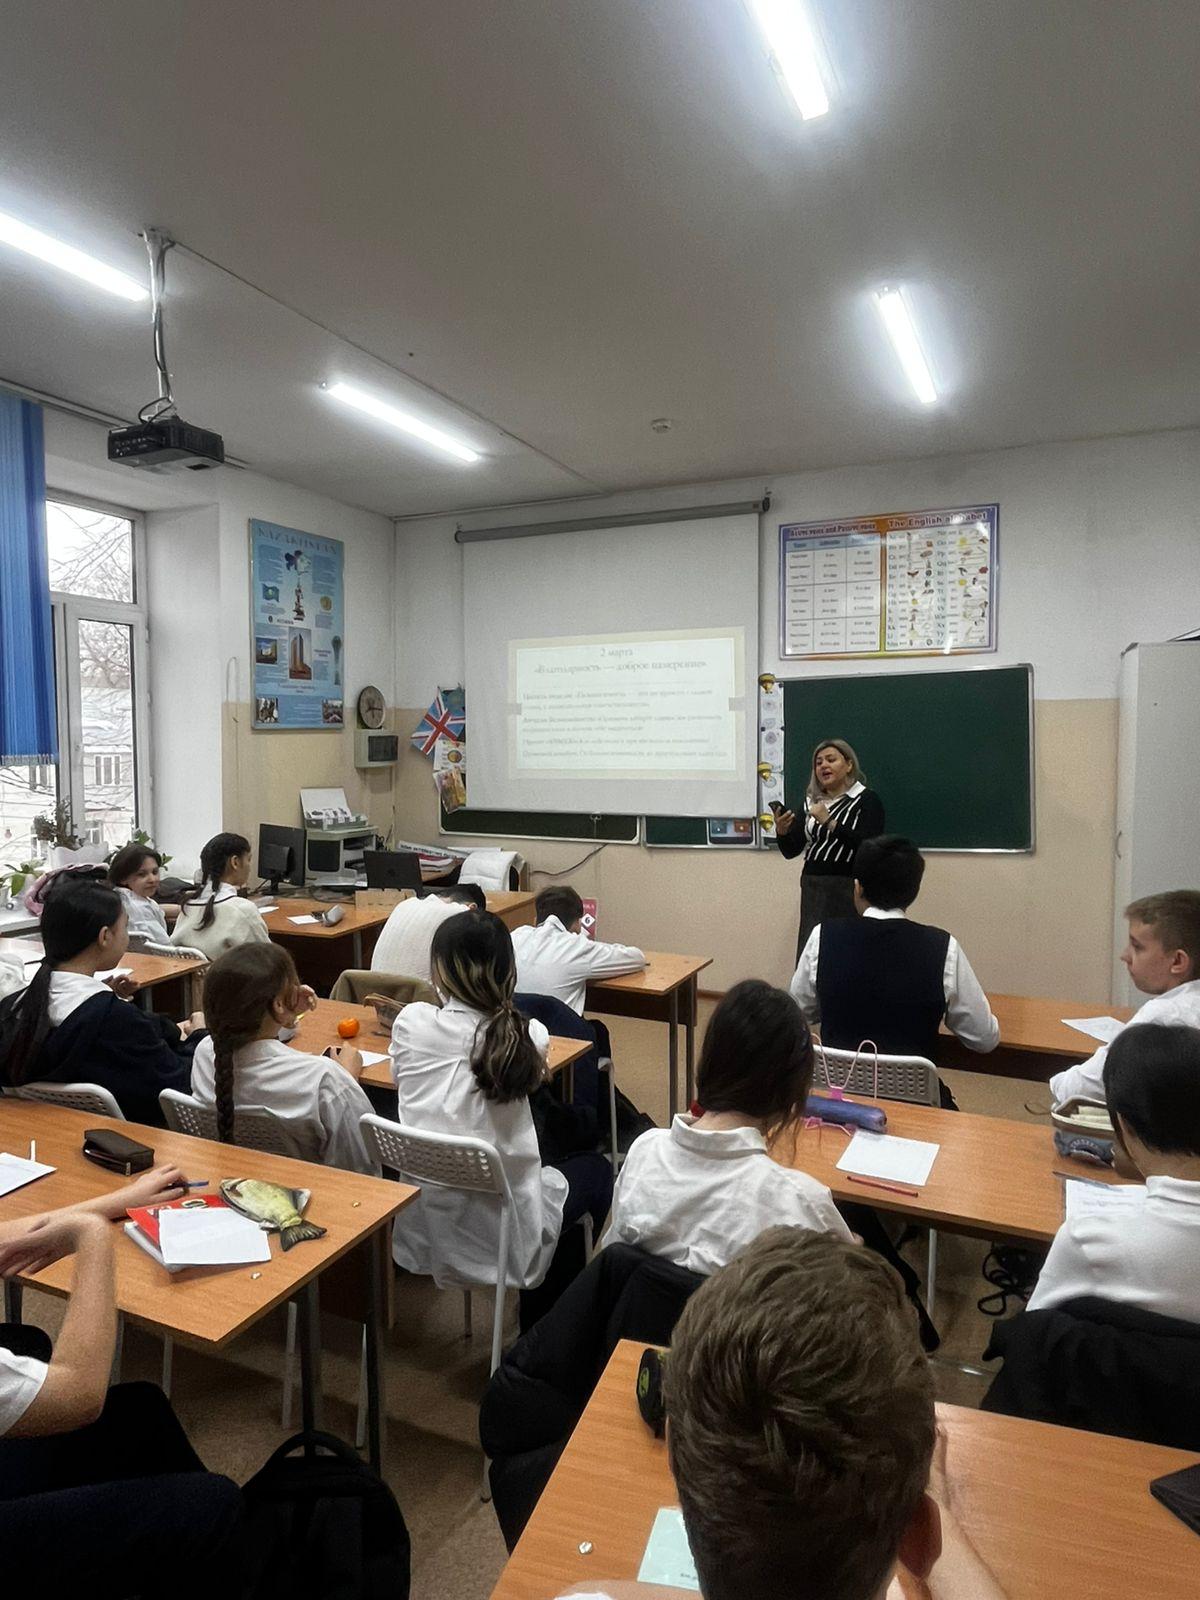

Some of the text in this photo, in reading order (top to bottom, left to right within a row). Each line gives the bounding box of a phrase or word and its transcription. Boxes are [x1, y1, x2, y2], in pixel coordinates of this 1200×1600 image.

[889, 518, 906, 529] The
[909, 515, 942, 528] English
[826, 525, 836, 533] and
[258, 526, 337, 555] KAZAKHSTAN
[600, 647, 634, 659] 2 марта
[616, 661, 649, 672] доброе
